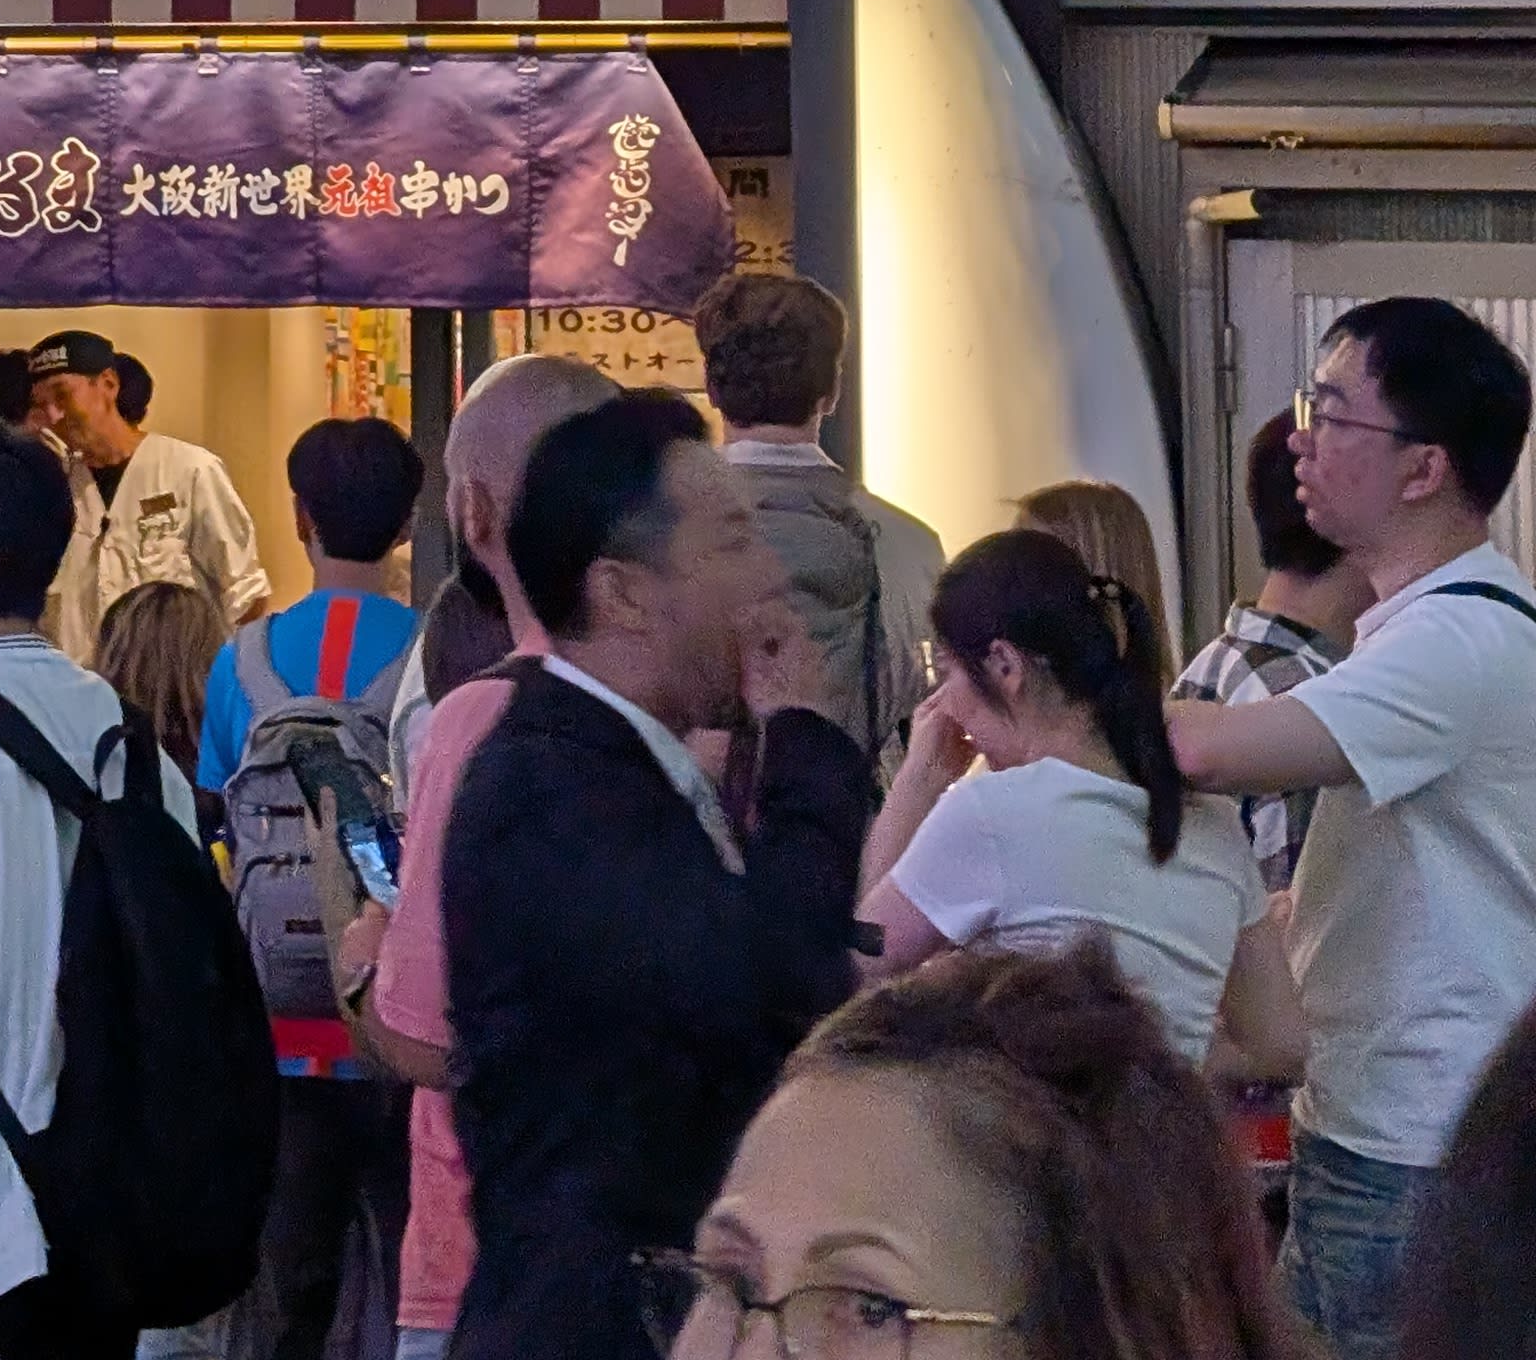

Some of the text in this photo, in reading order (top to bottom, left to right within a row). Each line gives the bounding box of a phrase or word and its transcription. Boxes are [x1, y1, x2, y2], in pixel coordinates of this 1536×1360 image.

[120, 160, 512, 222] 大阪新世界元祖串かつ
[566, 351, 695, 371] ストオー
